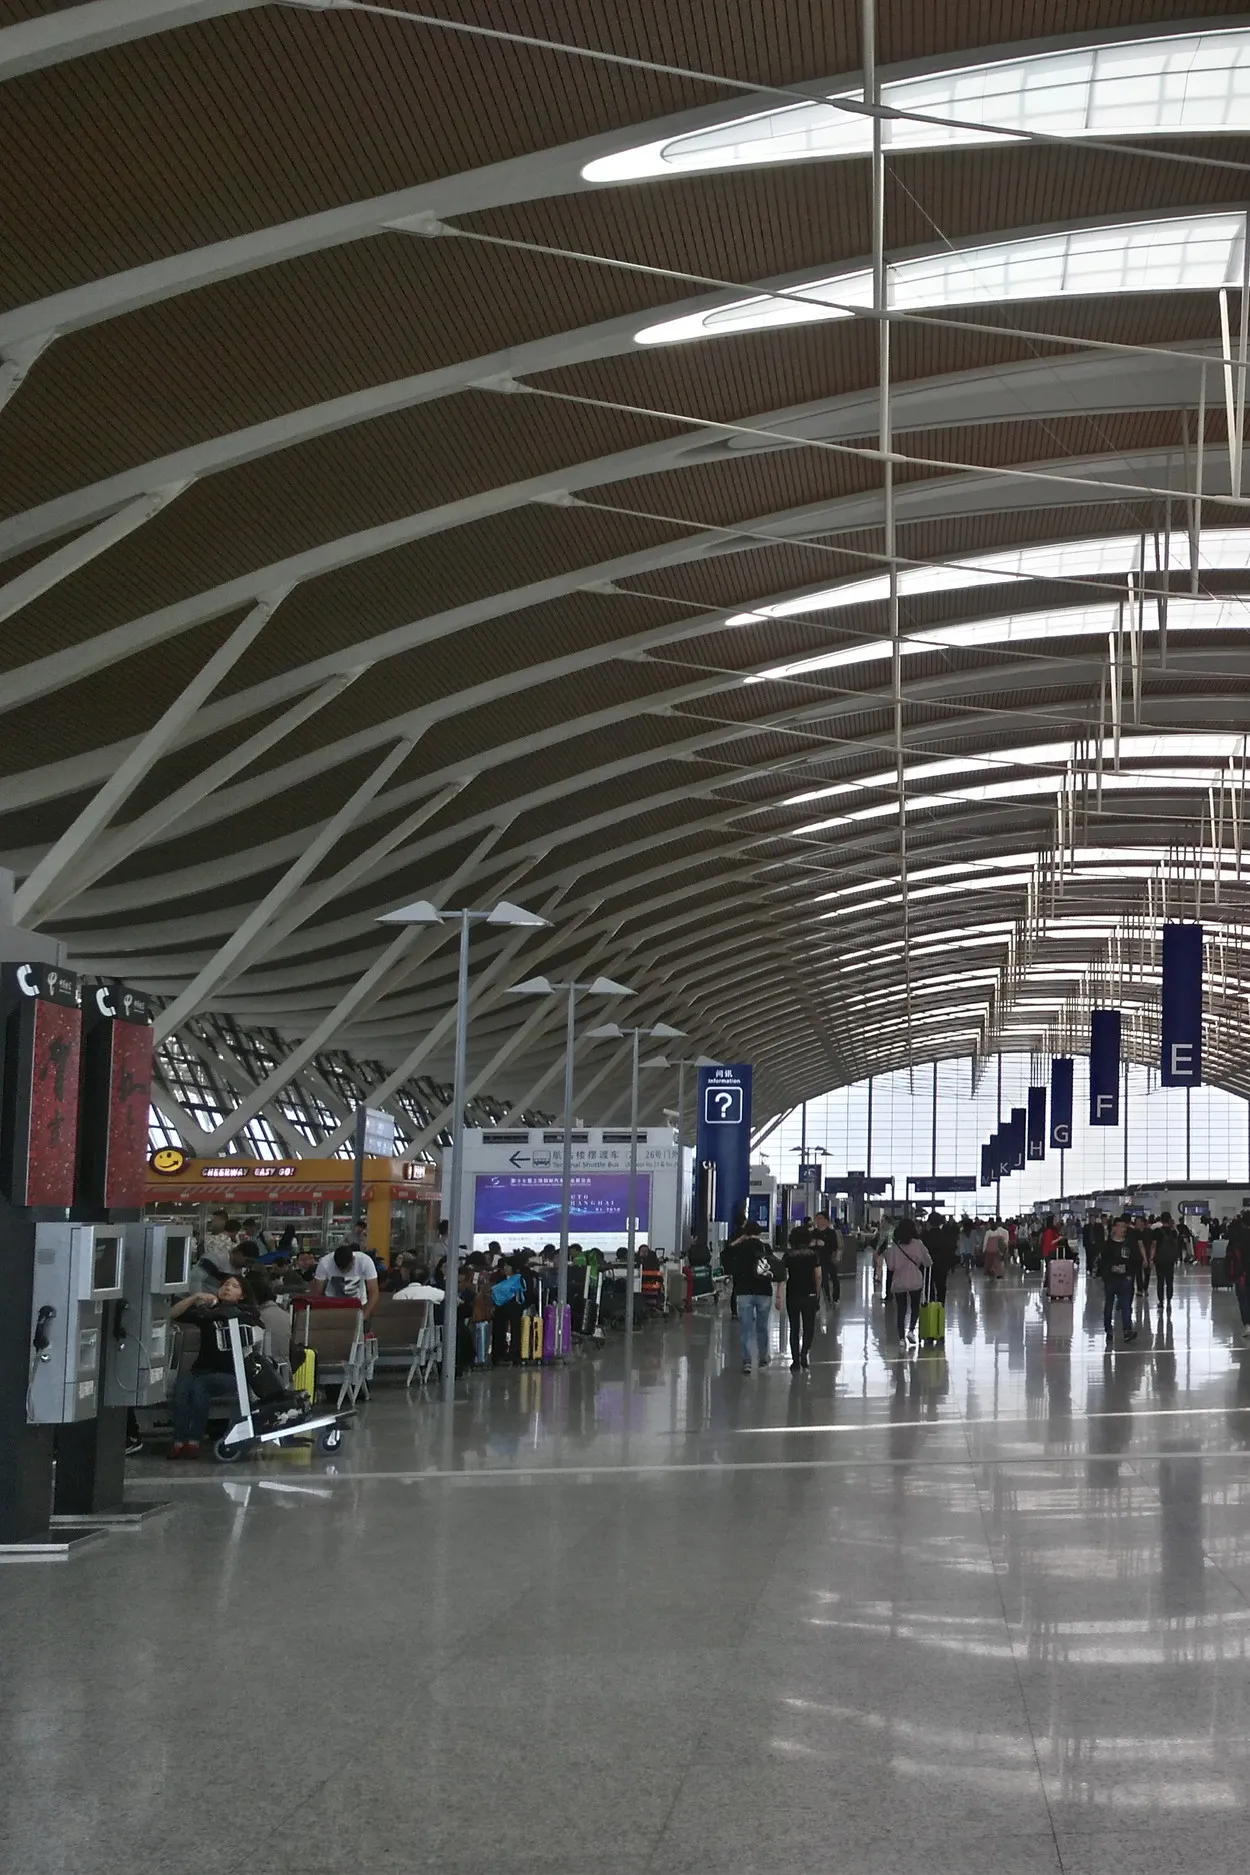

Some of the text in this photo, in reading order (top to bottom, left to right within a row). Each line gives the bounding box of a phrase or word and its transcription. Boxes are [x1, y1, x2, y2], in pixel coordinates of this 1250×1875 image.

[1171, 1043, 1194, 1075] E
[1097, 1094, 1114, 1118] F
[1053, 1124, 1069, 1143] G
[1030, 1140, 1043, 1156] H
[1014, 1152, 1022, 1167] J
[202, 1167, 248, 1178] CHEERWAY
[253, 1167, 276, 1177] EASY
[991, 1169, 999, 1180] L
[1000, 1162, 1009, 1174] K
